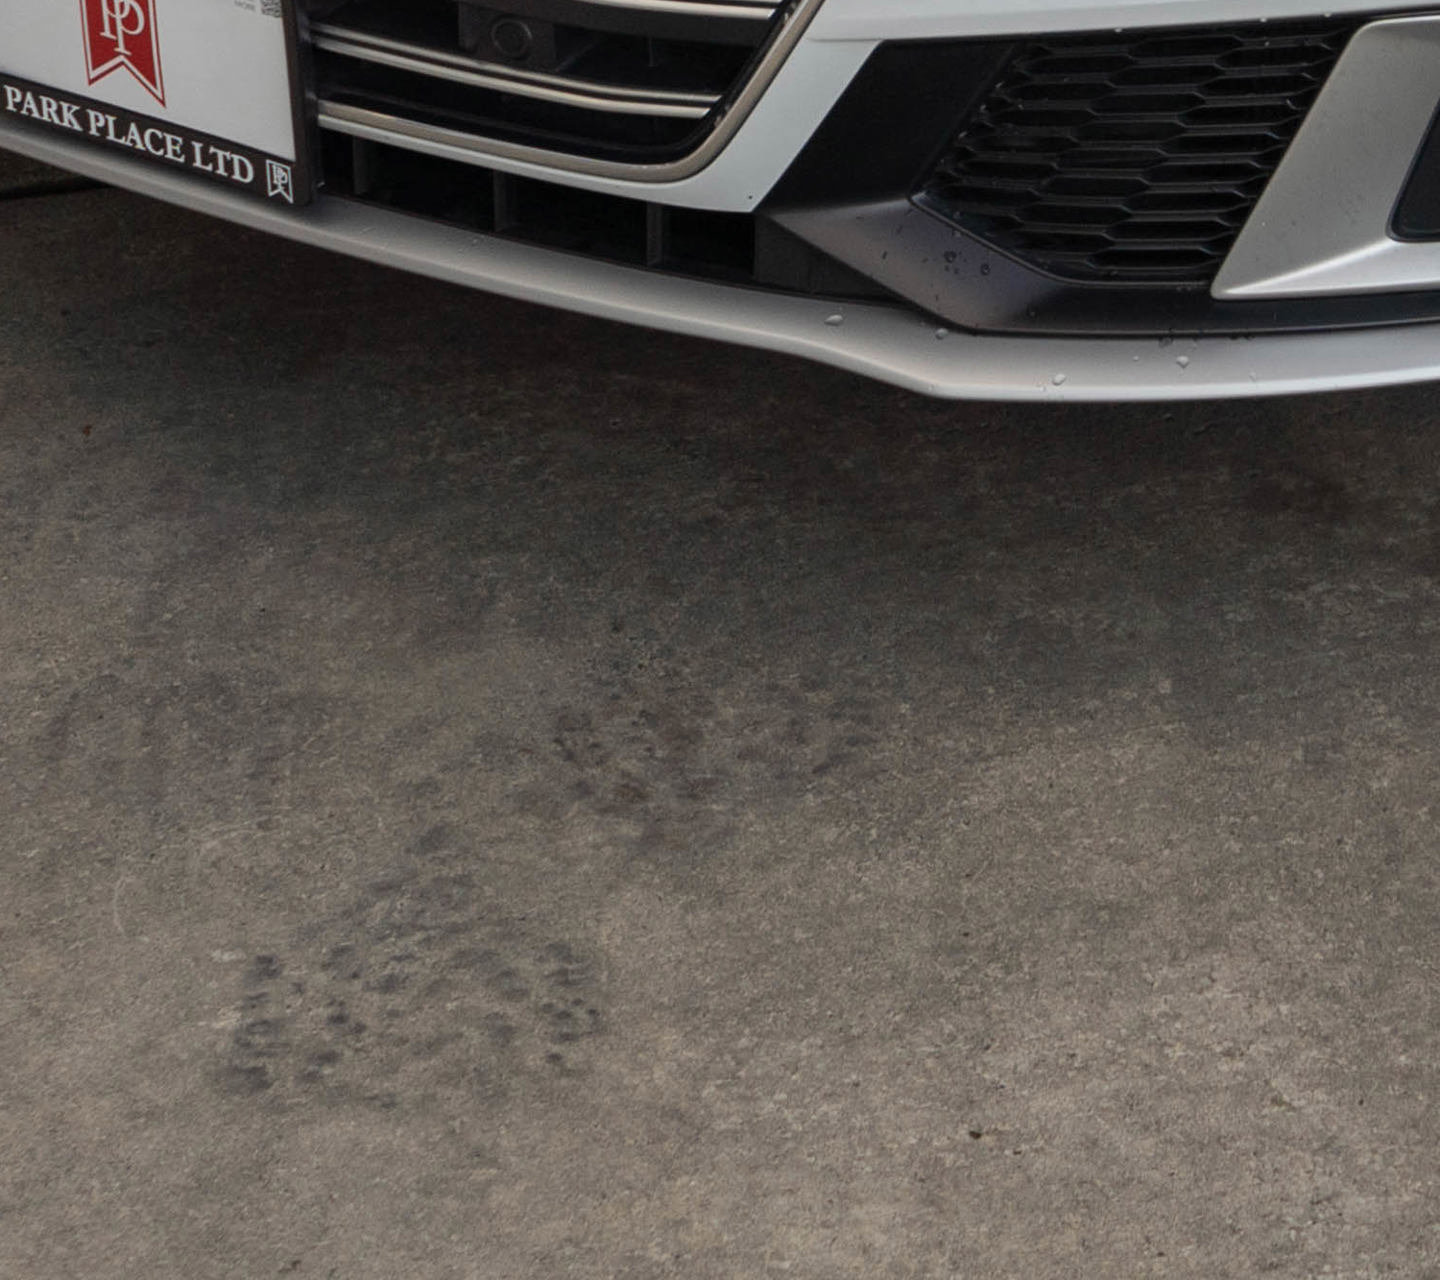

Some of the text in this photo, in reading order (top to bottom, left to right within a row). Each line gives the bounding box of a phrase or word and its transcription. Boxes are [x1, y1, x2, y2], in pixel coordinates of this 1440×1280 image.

[3, 85, 255, 184] PARK PLACE LTD
